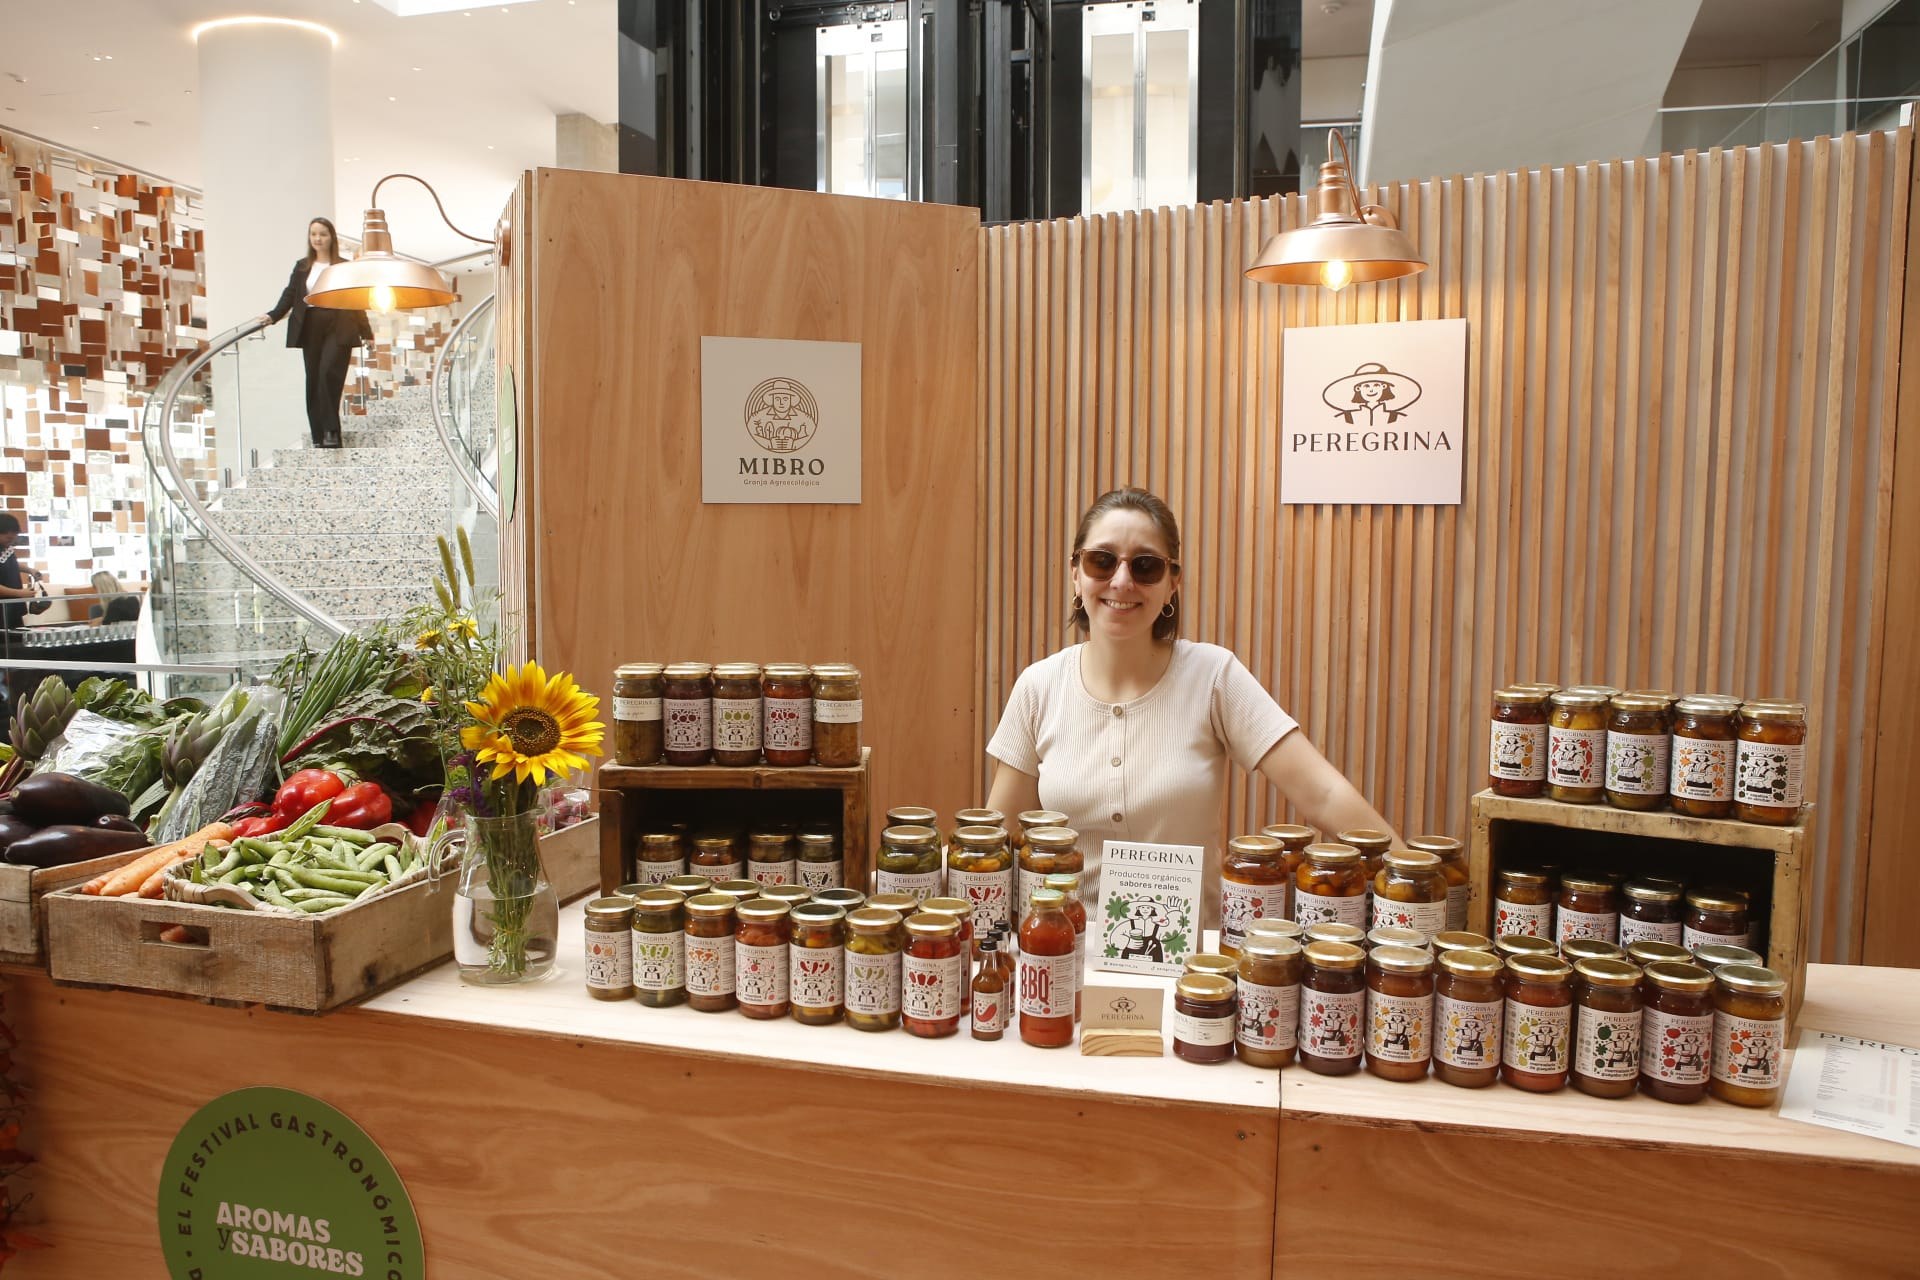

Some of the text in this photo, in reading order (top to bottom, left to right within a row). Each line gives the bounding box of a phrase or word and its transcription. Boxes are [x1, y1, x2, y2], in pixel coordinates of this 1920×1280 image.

[1292, 430, 1452, 453] PEREGRINA
[738, 457, 825, 476] MIBRO
[743, 478, 820, 487] Granja Agroecológica
[1110, 847, 1194, 865] PEREGRINA
[1109, 869, 1193, 884] Productos orgánicos,
[1119, 879, 1152, 889] sabores
[1021, 962, 1050, 1006] BBQ
[1101, 1013, 1144, 1021] PEREGRINA
[180, 1112, 260, 1198] FESTIVAL
[177, 1209, 192, 1236] EL
[216, 1201, 331, 1244] AROMAS
[231, 1230, 364, 1277] SABORES
